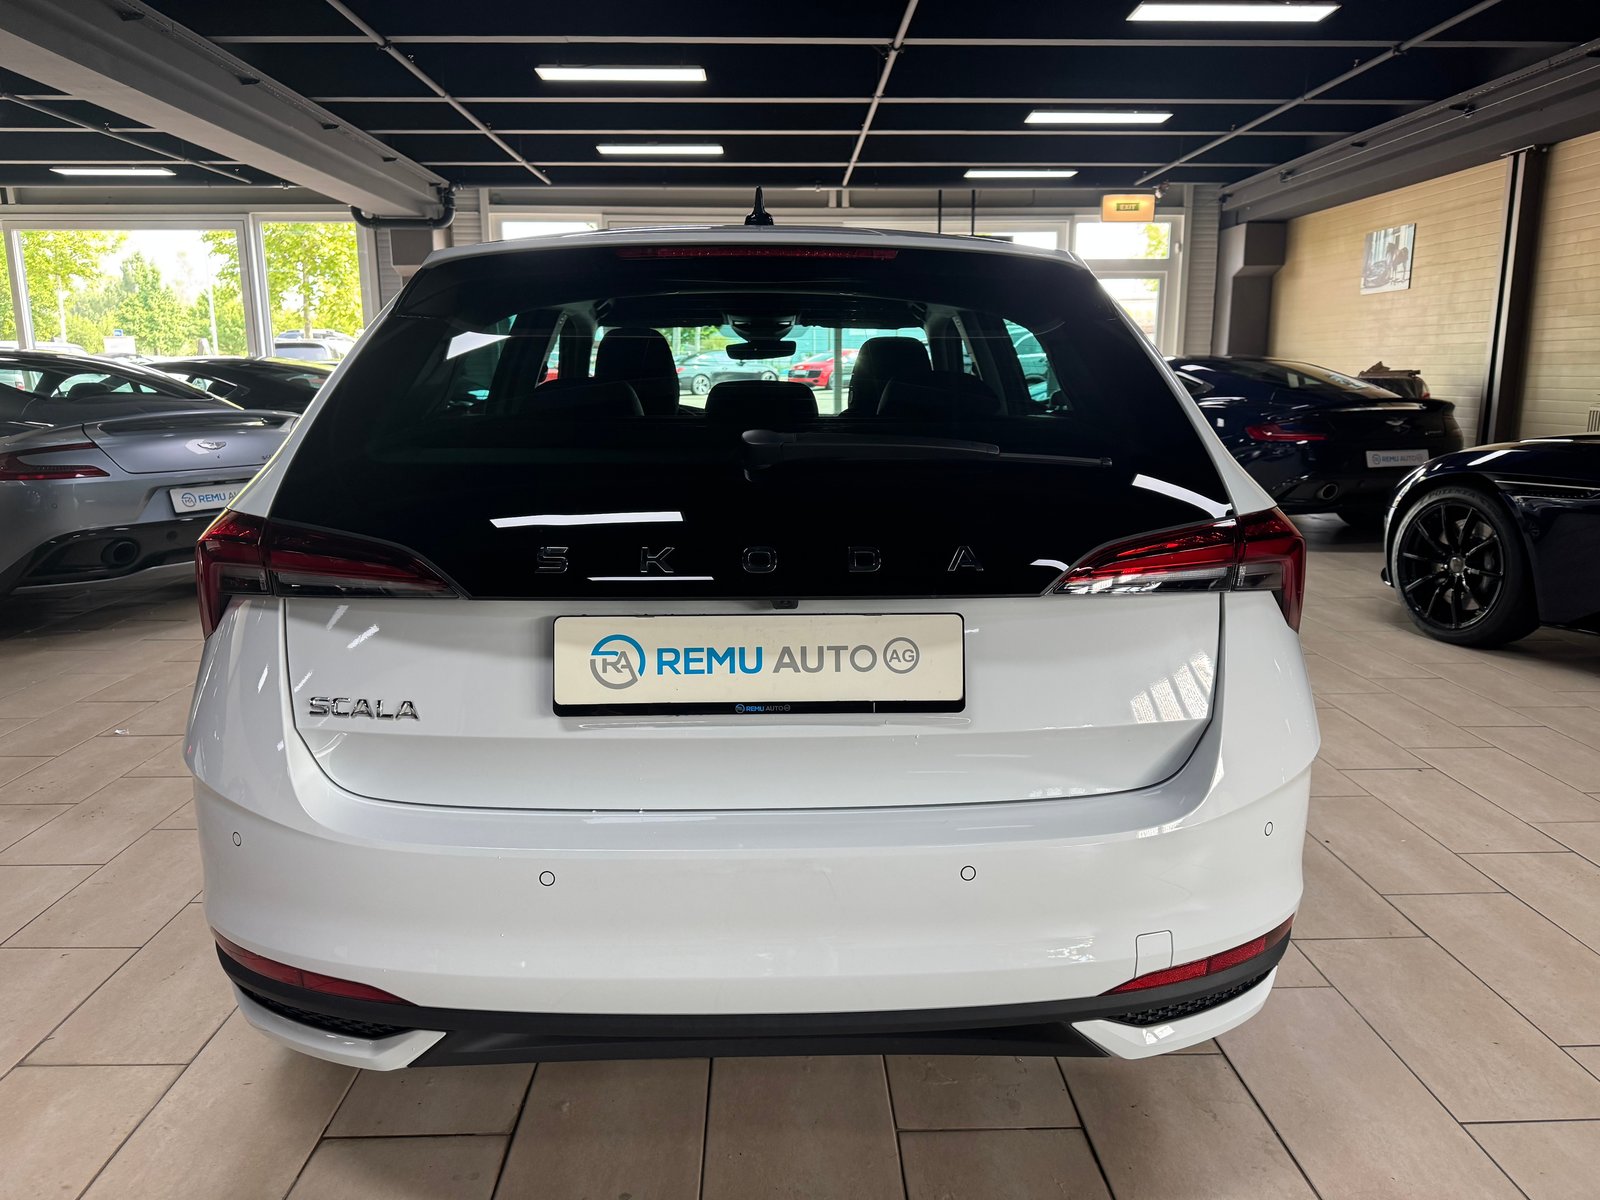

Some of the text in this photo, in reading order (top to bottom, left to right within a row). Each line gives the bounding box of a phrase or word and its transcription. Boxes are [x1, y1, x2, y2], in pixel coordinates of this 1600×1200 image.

[198, 492, 226, 503] REMU
[534, 545, 984, 573] SKODA
[657, 646, 763, 675] REMU
[772, 644, 877, 674] AUTO
[309, 697, 420, 720] SCALA
